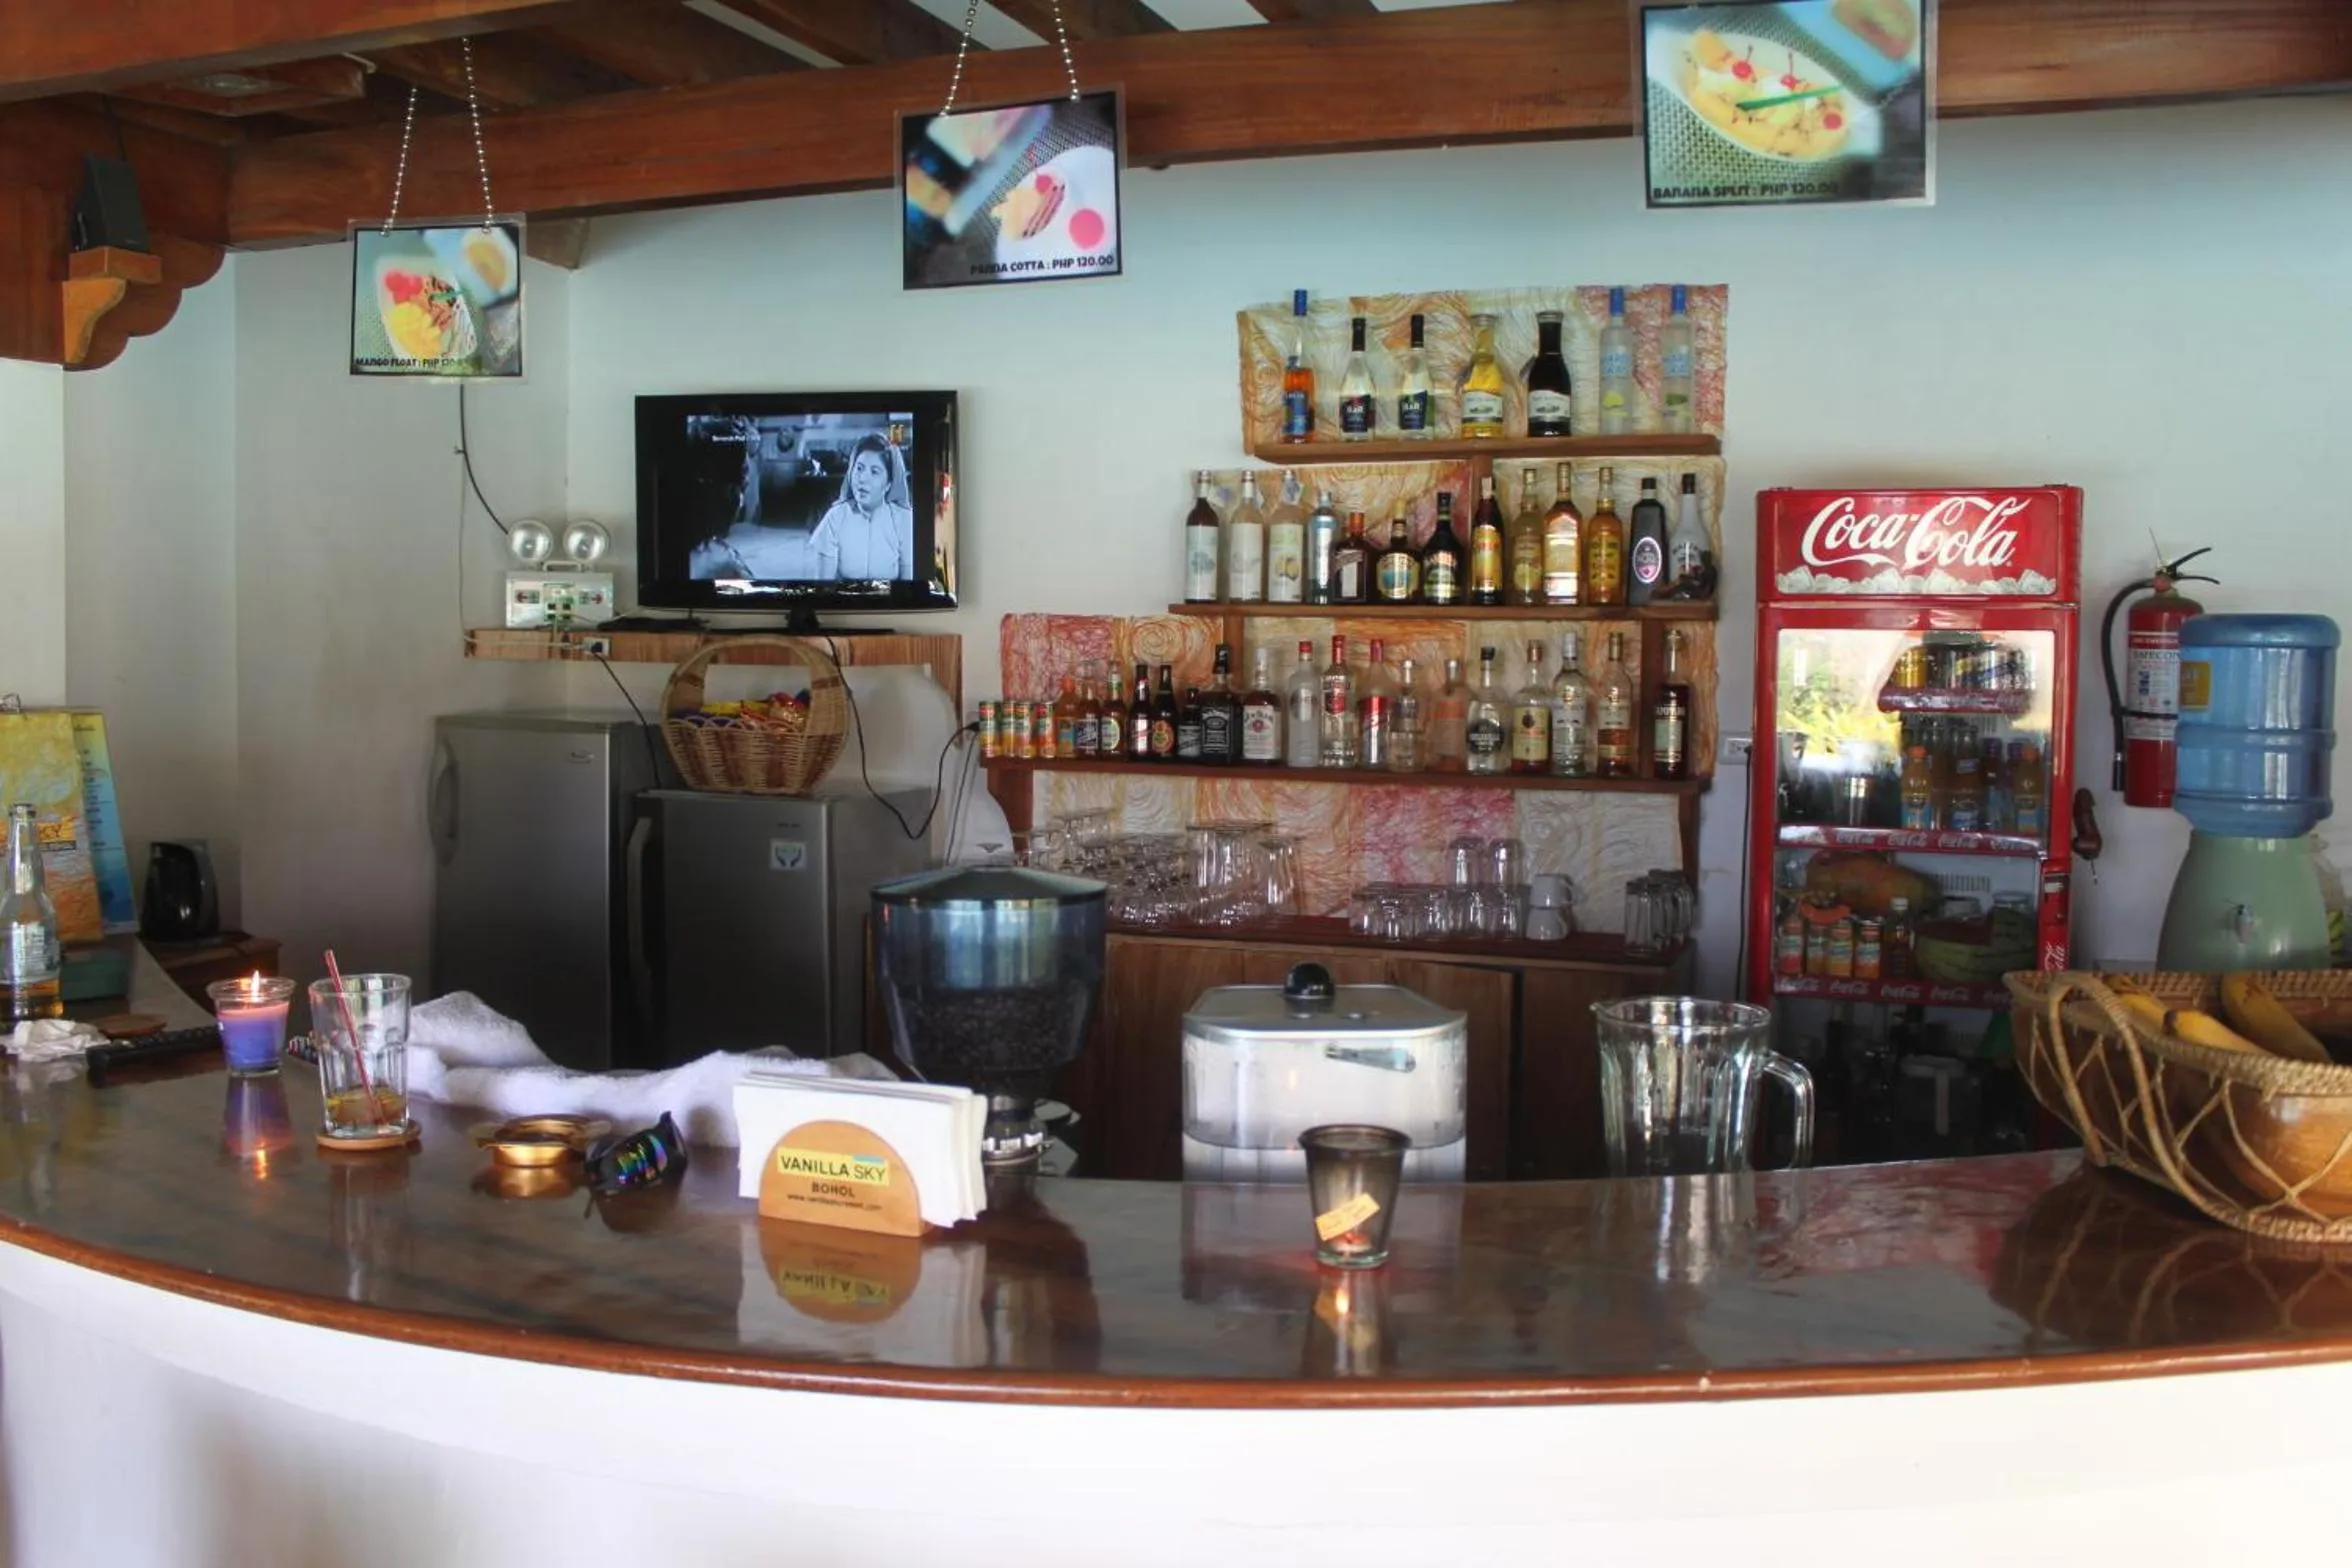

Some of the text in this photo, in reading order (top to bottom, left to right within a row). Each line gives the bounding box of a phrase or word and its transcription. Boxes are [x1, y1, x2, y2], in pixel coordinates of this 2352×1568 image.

[1714, 185, 1750, 198] SPLIT
[1010, 260, 1044, 272] COTTA
[1052, 258, 1074, 270] PHP
[1801, 496, 2032, 571] Coca-Cola
[781, 1156, 885, 1182] VANILLA SKY
[812, 1181, 855, 1197] BOHOL
